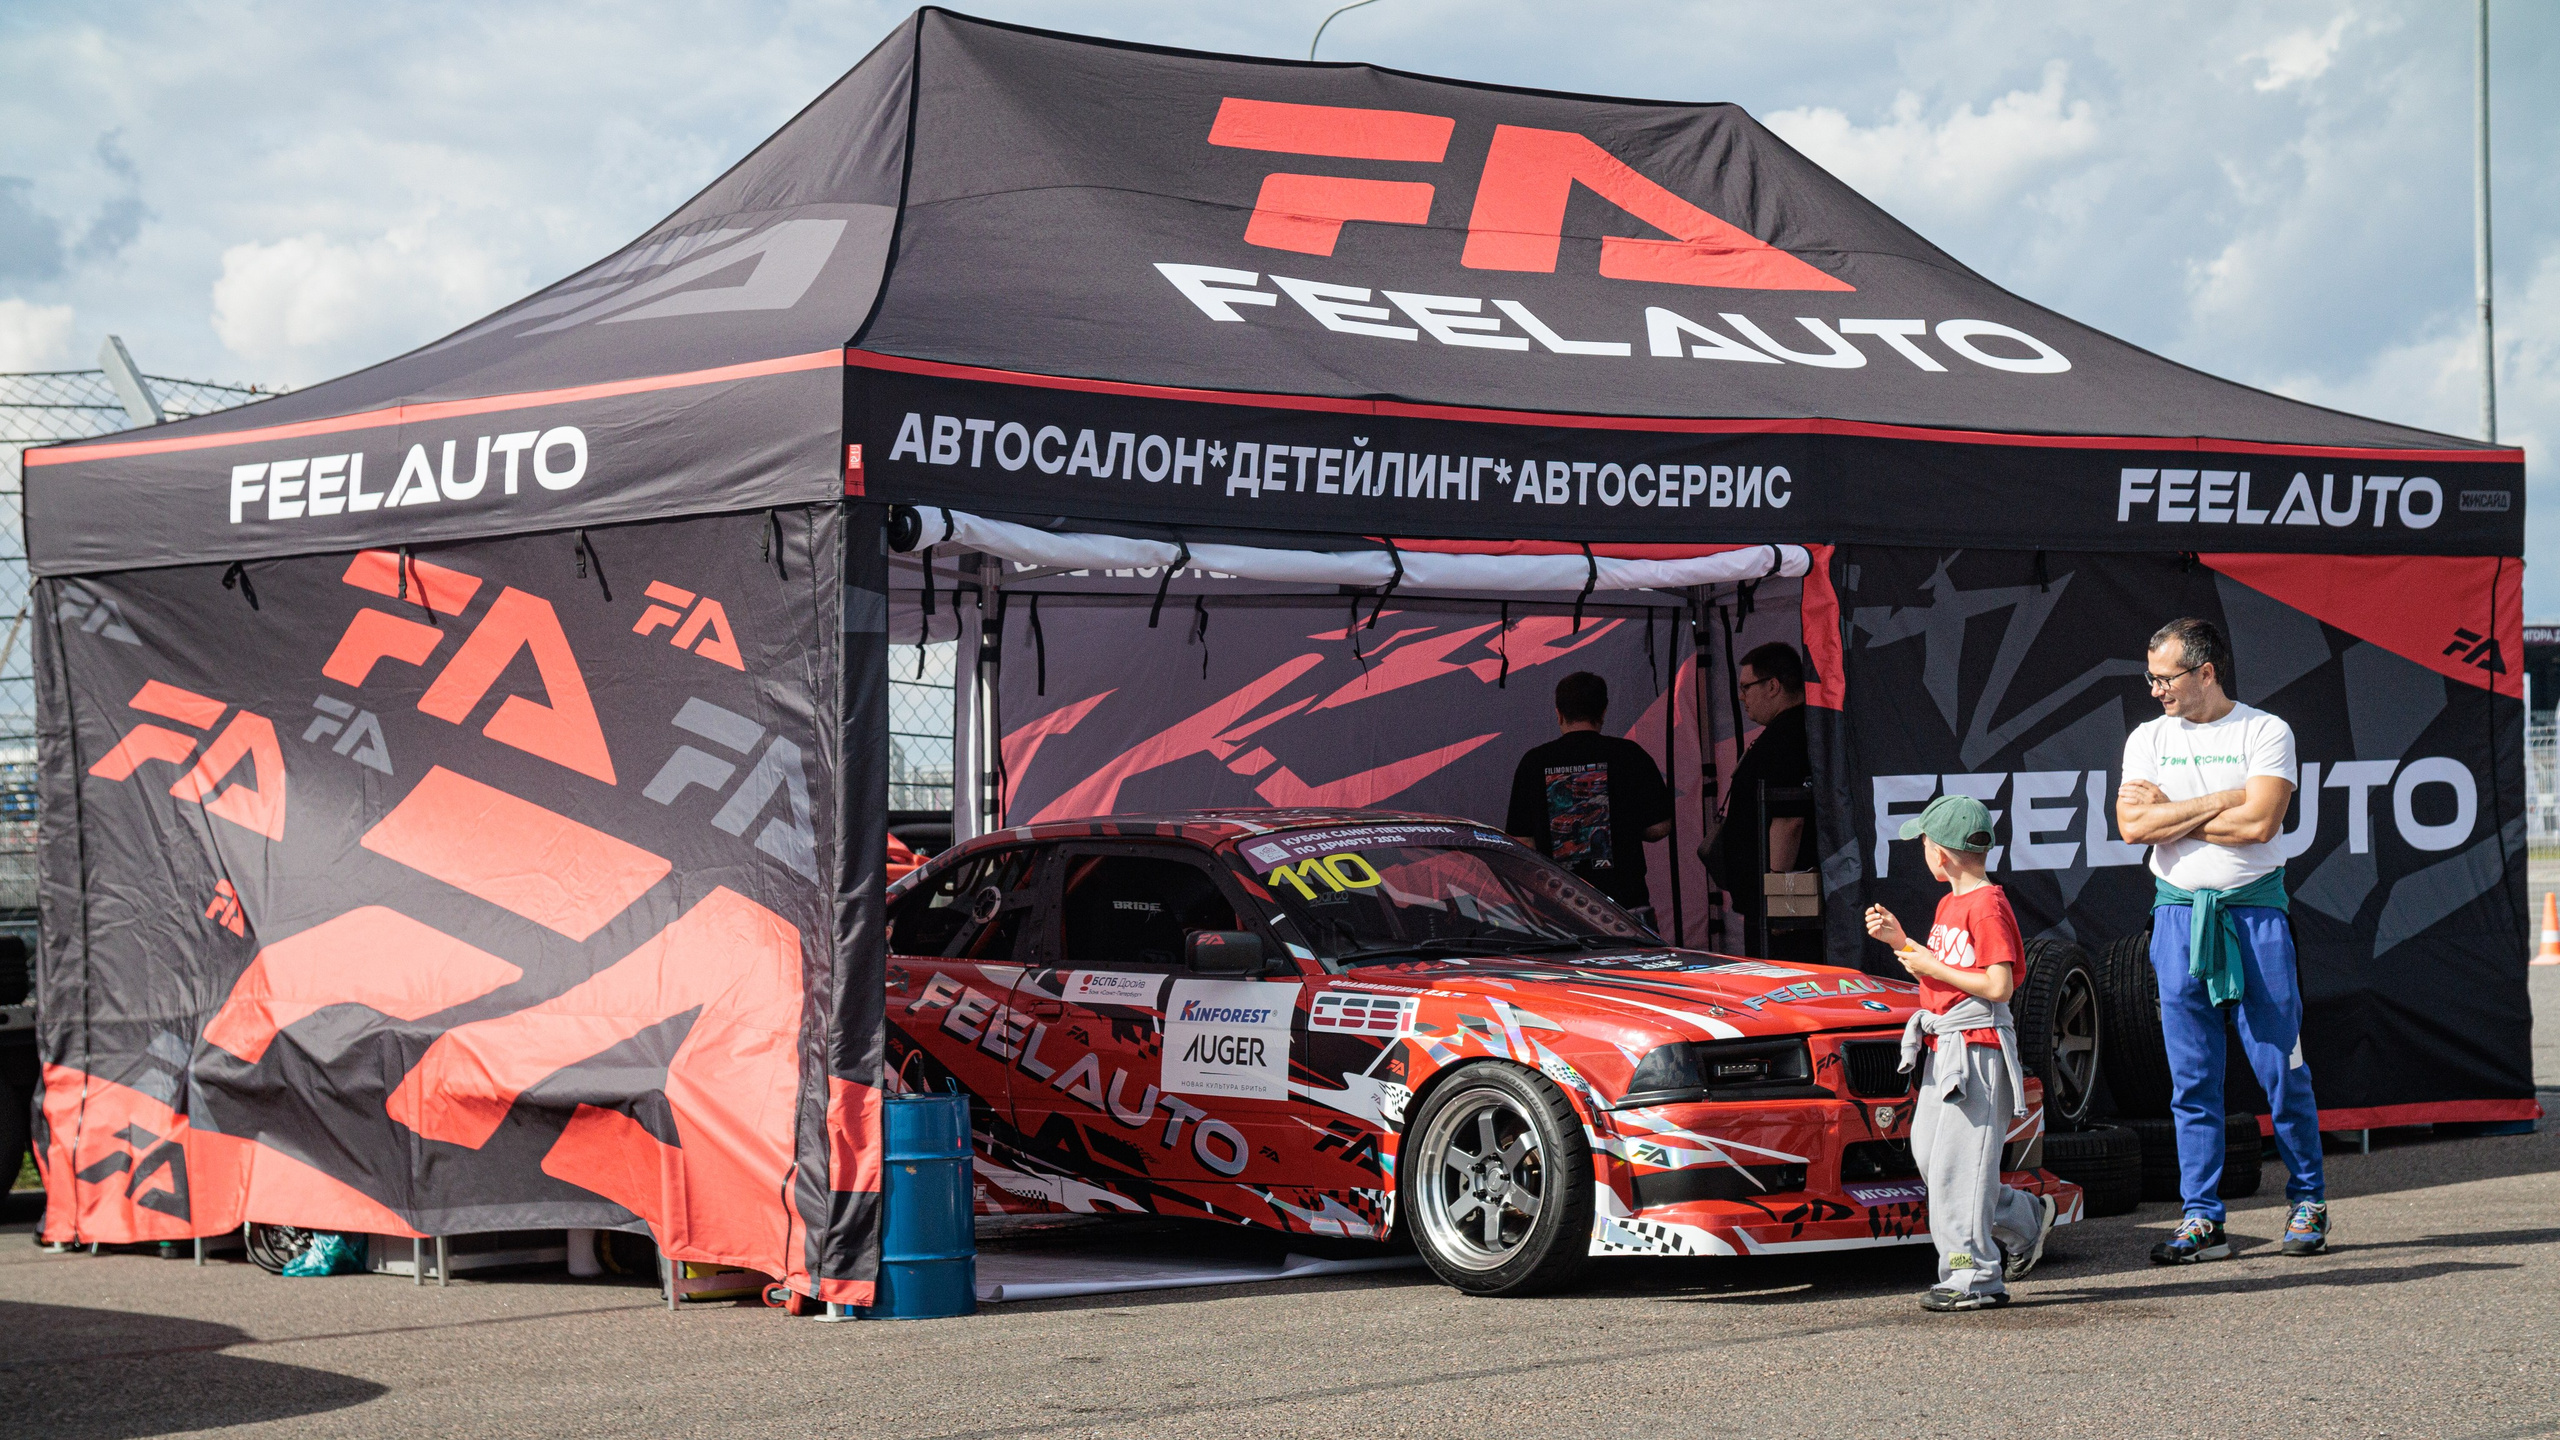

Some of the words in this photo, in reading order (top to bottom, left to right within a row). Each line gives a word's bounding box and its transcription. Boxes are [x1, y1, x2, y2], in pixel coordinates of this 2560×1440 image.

[1153, 262, 2073, 374] FEELAUTO
[229, 426, 588, 525] FEELAUTO
[2117, 468, 2443, 530] FEELAUTO
[1544, 764, 1587, 775] FILIMONENOK
[2160, 756, 2188, 766] JOHN
[1872, 756, 2478, 879] FELUTO
[1281, 830, 1331, 847] КУБОК
[1331, 825, 1456, 839] САНКТ-ПЕТЕРБУРГА
[1293, 844, 1317, 855] ПО
[1317, 836, 1374, 852] ДРИФТУ
[1267, 853, 1382, 901] 110
[1112, 900, 1164, 912] BRIDE
[1092, 976, 1119, 987] БСПБ
[1117, 977, 1146, 989] Драйв
[1742, 978, 1920, 1011] FEELAU
[1183, 1033, 1268, 1067] AUGER
[906, 971, 1250, 1177] FEELAUTO
[1181, 1080, 1204, 1088] НОВАЯ
[1206, 1082, 1239, 1091] КУЛЬТУРА
[1241, 1084, 1267, 1092] БРИТЬЯ
[1852, 1187, 1916, 1201] ИГОРА
